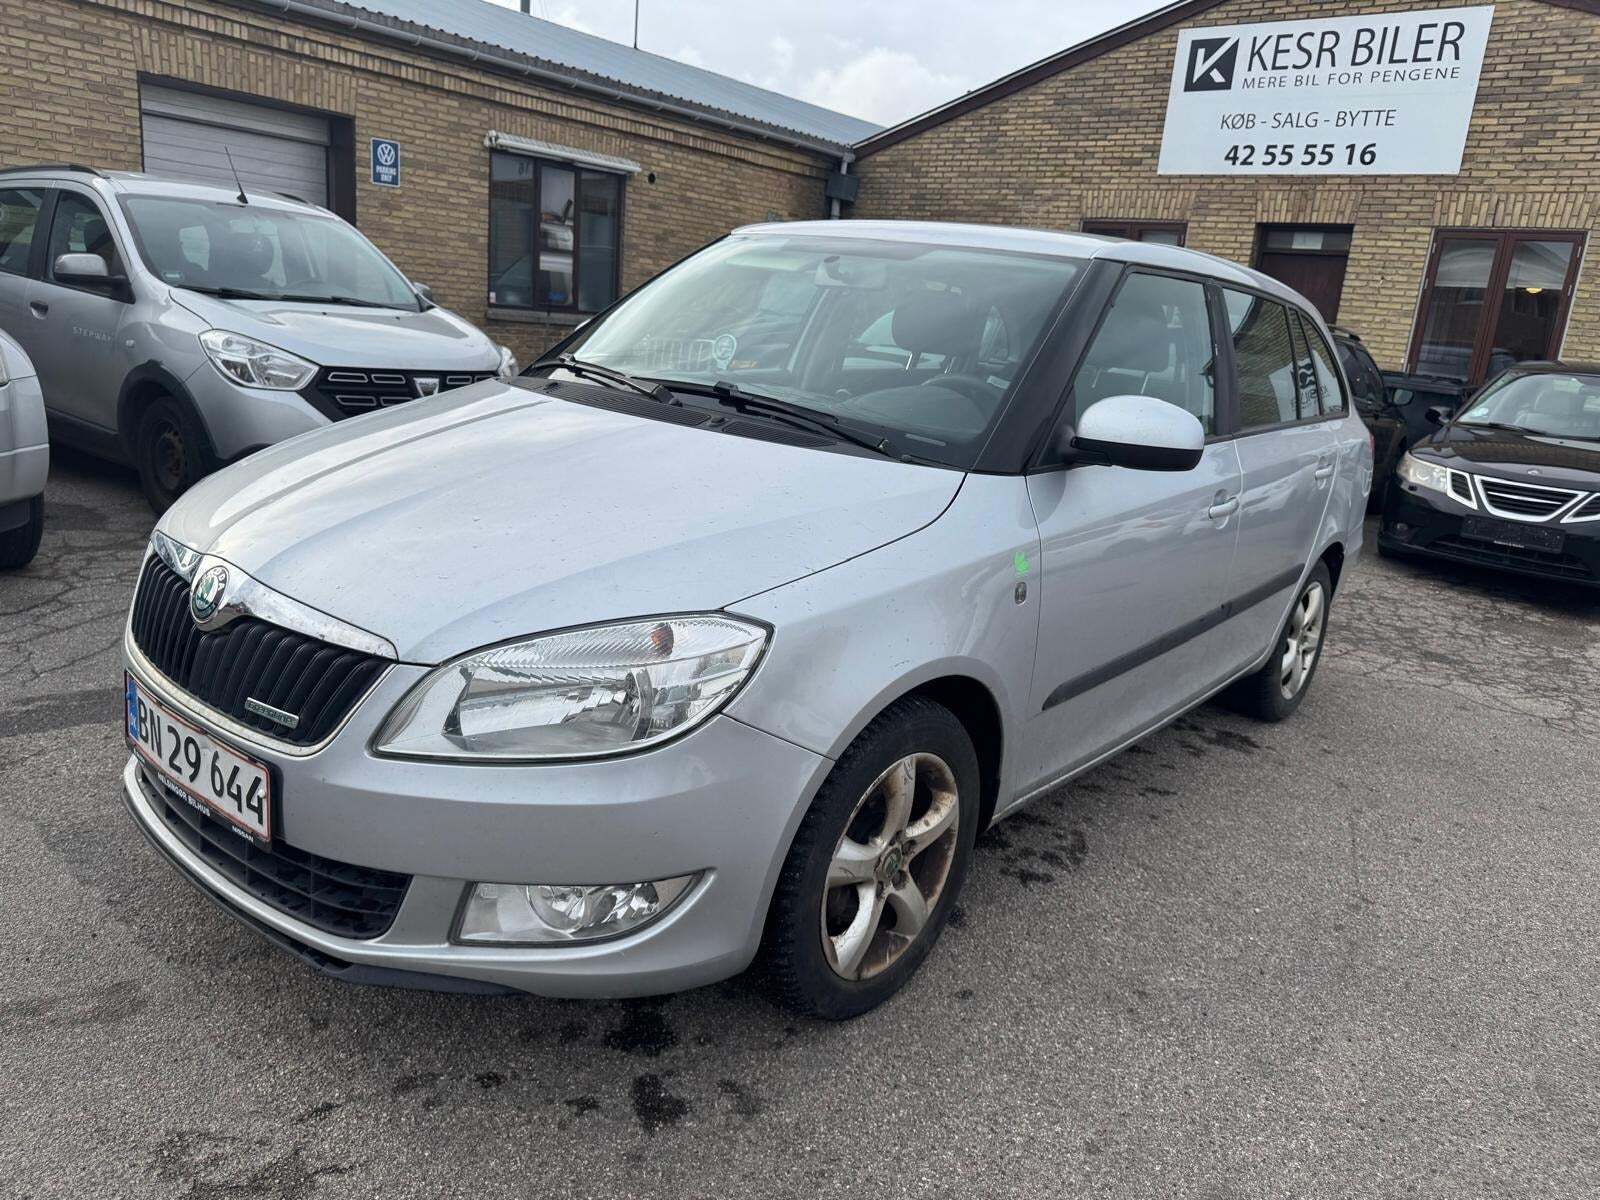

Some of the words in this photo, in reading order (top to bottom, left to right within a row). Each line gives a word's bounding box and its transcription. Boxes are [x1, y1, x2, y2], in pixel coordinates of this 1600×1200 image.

[1247, 30, 1340, 72] KESR
[1350, 21, 1466, 67] BILER
[1241, 75, 1288, 90] MERE
[1294, 73, 1320, 88] BIL
[1327, 71, 1363, 86] FOR
[1370, 66, 1462, 84] PENGENE
[1220, 113, 1256, 130] KØB
[1271, 111, 1319, 129] SALG
[1335, 109, 1397, 128] BYTTE
[1224, 144, 1255, 166] 42
[1262, 144, 1295, 166] 55
[1301, 144, 1335, 166] 55
[1344, 143, 1377, 166] 16
[138, 695, 162, 759] BN
[167, 724, 201, 783] 29
[211, 751, 264, 825] 644
